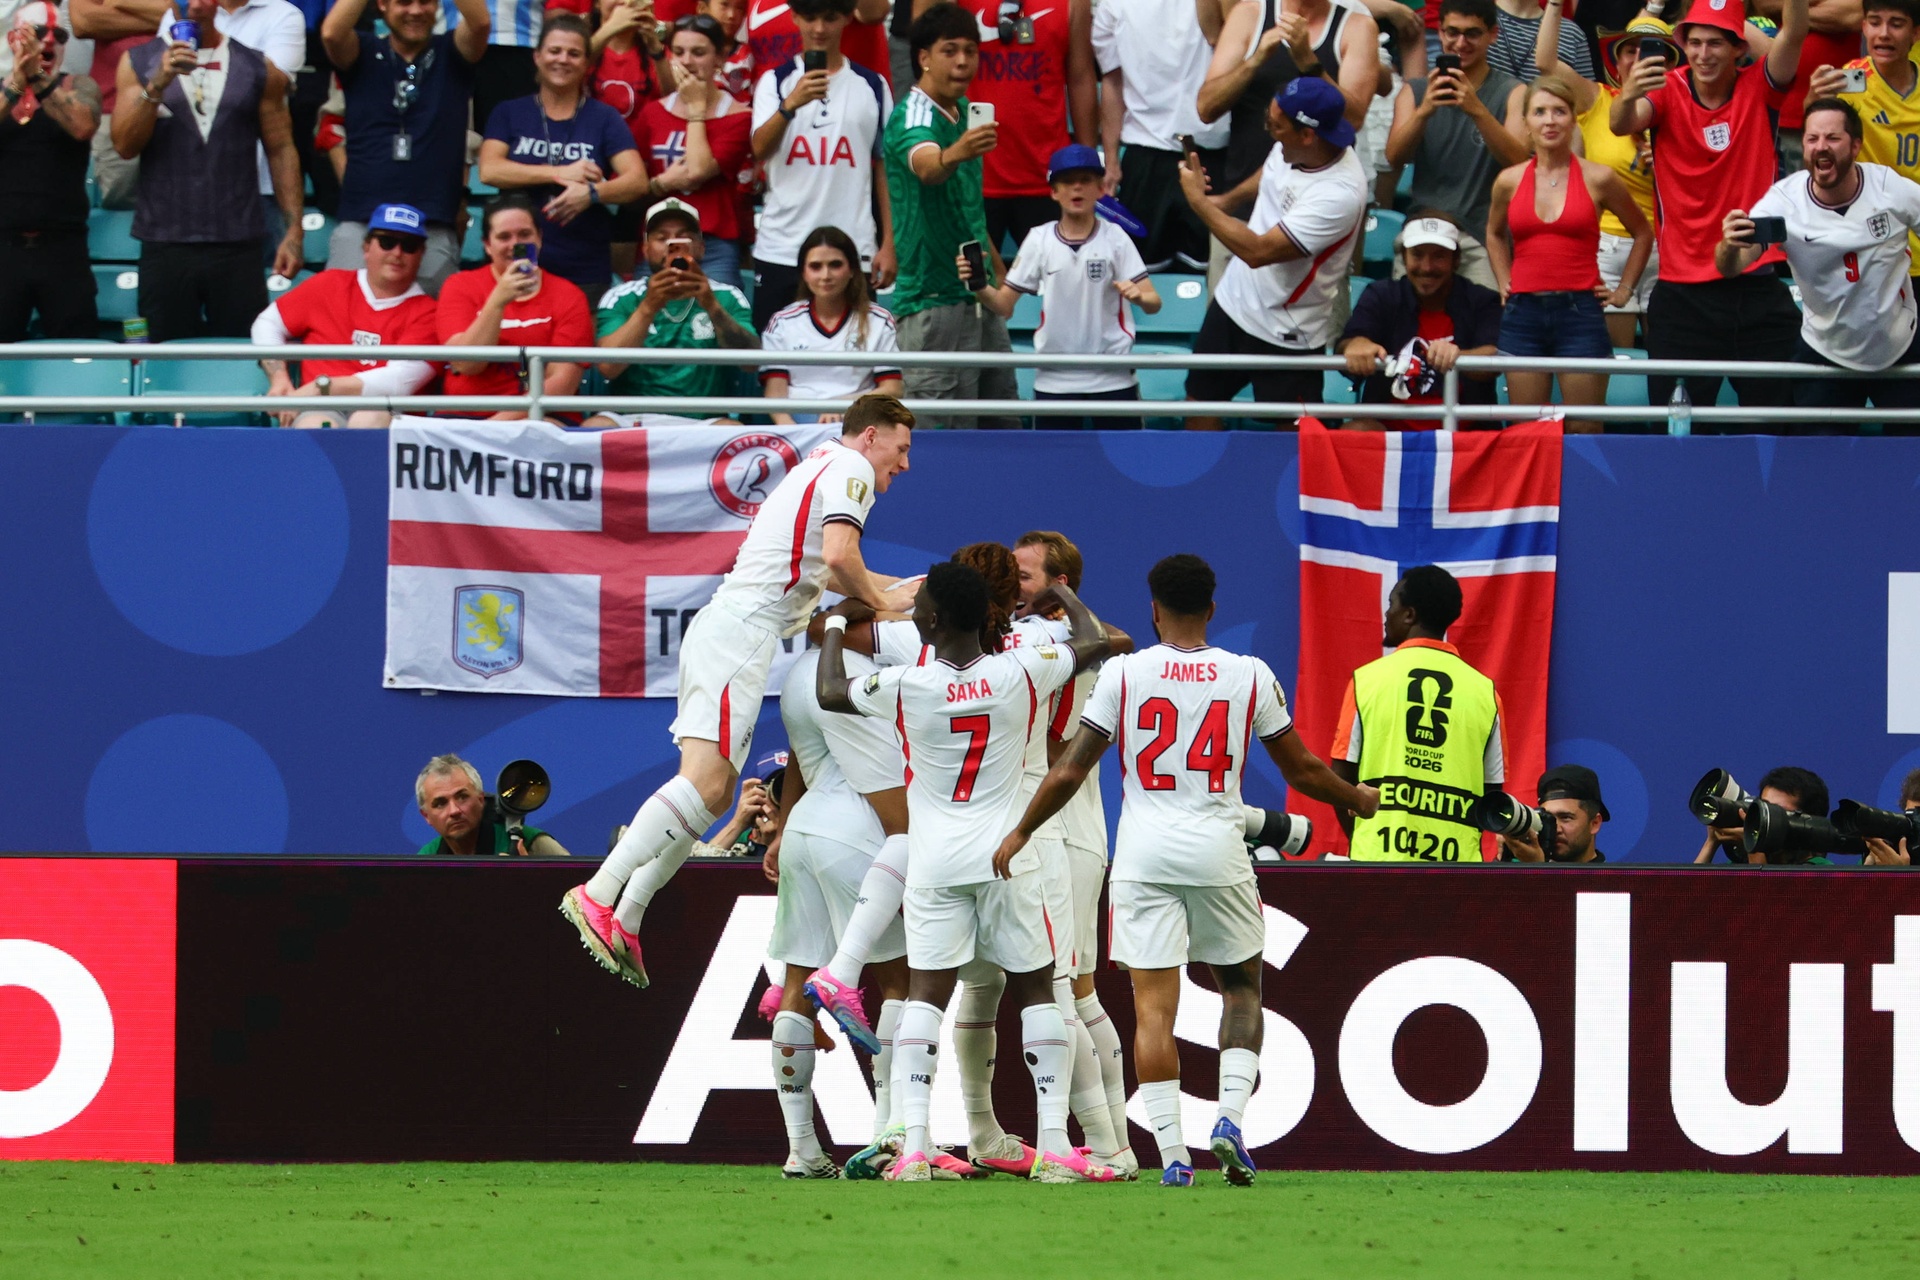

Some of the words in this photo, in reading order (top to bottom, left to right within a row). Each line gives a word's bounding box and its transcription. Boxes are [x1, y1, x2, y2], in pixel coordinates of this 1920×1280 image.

[513, 135, 595, 162] NORGE
[785, 135, 857, 168] AIA
[1895, 132, 1919, 168] 10
[1843, 251, 1860, 283] 9
[726, 435, 786, 456] BRISTOL
[396, 442, 594, 502] ROMFORD
[993, 633, 1022, 653] CE
[1160, 660, 1218, 683] JAMES
[946, 678, 993, 703] SAKA
[1136, 696, 1233, 793] 24
[1415, 728, 1435, 742] FIFA
[950, 713, 990, 802] 7
[1405, 755, 1443, 773] 2026
[1430, 752, 1444, 760] CUP
[1379, 783, 1474, 819] ECURITY
[1037, 1075, 1055, 1085] ENG
